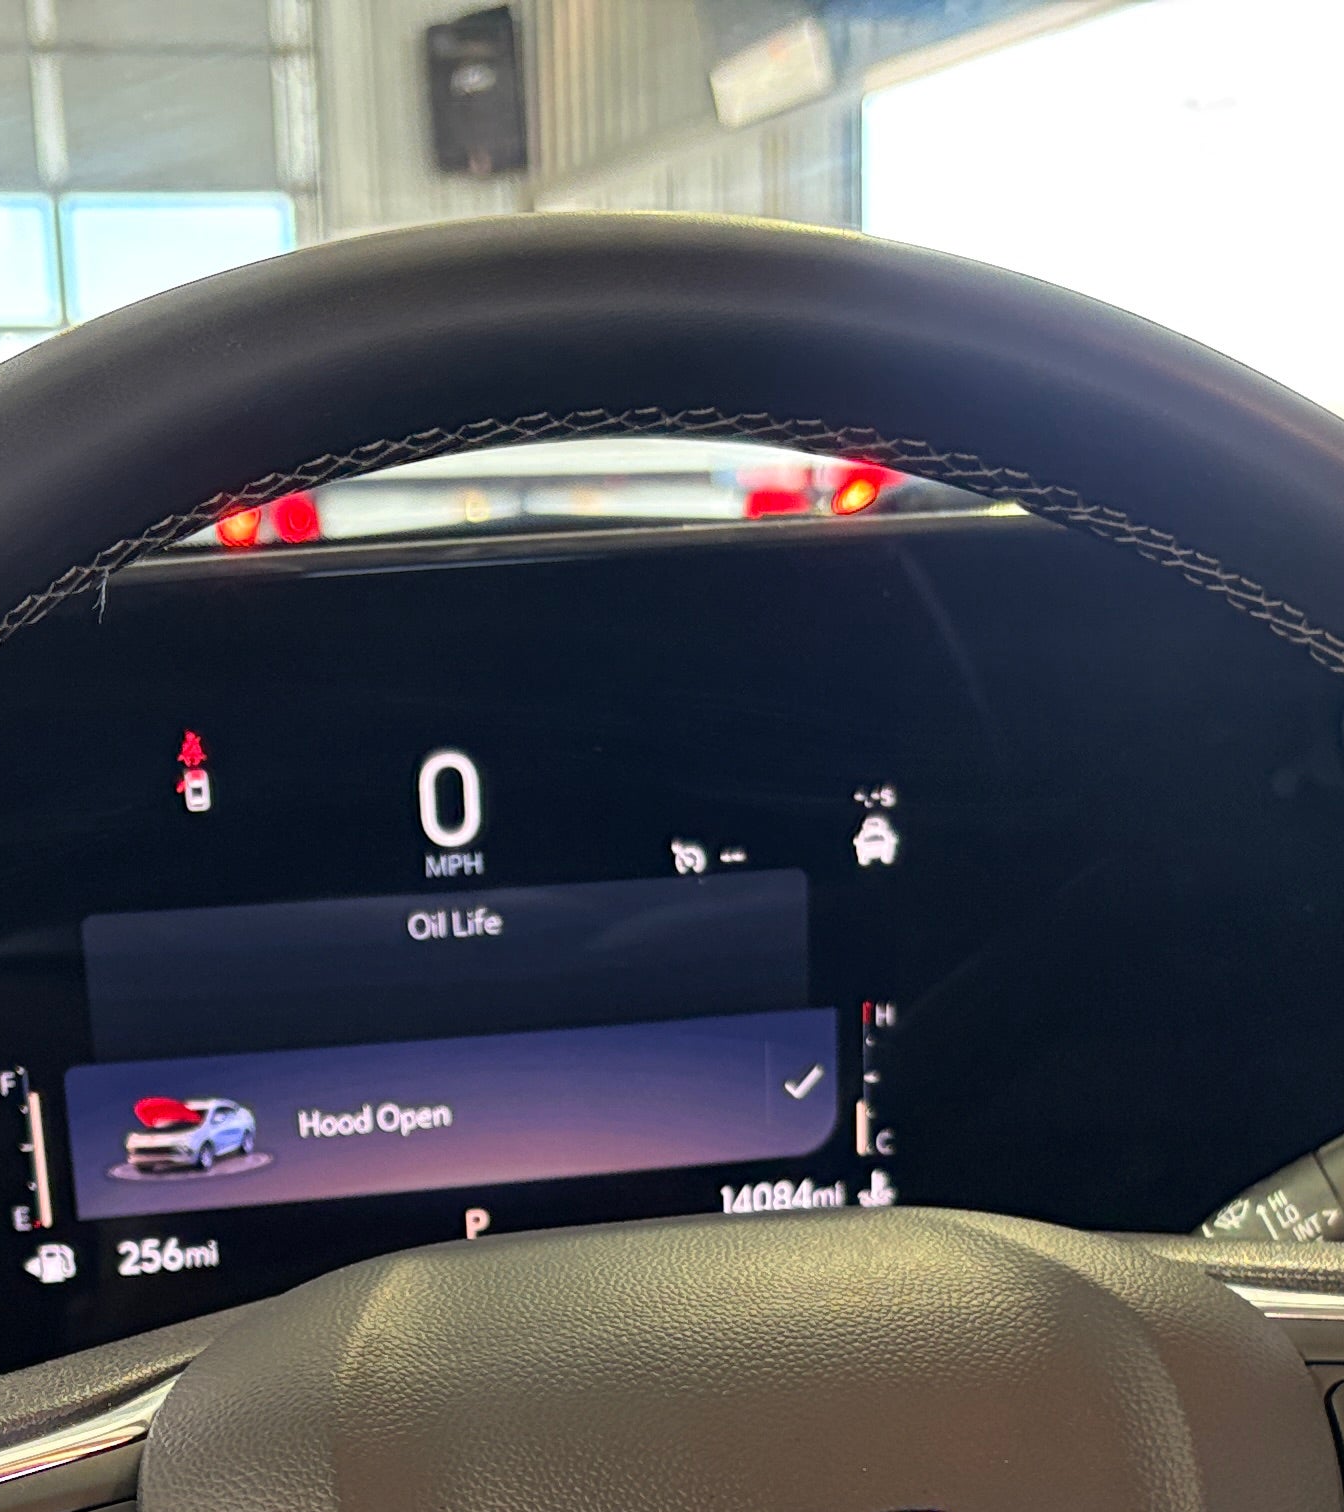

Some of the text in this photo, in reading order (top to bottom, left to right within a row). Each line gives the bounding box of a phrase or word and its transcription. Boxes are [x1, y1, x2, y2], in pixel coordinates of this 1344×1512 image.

[418, 748, 482, 849] 0
[425, 852, 484, 878] MPH
[407, 906, 504, 941] Oil Life
[875, 1000, 896, 1027] H
[0, 1071, 17, 1097] F
[298, 1101, 454, 1140] Hood Open
[875, 1129, 896, 1156] C
[13, 1206, 33, 1231] E
[465, 1208, 491, 1240] P
[117, 1236, 220, 1277] 256mi
